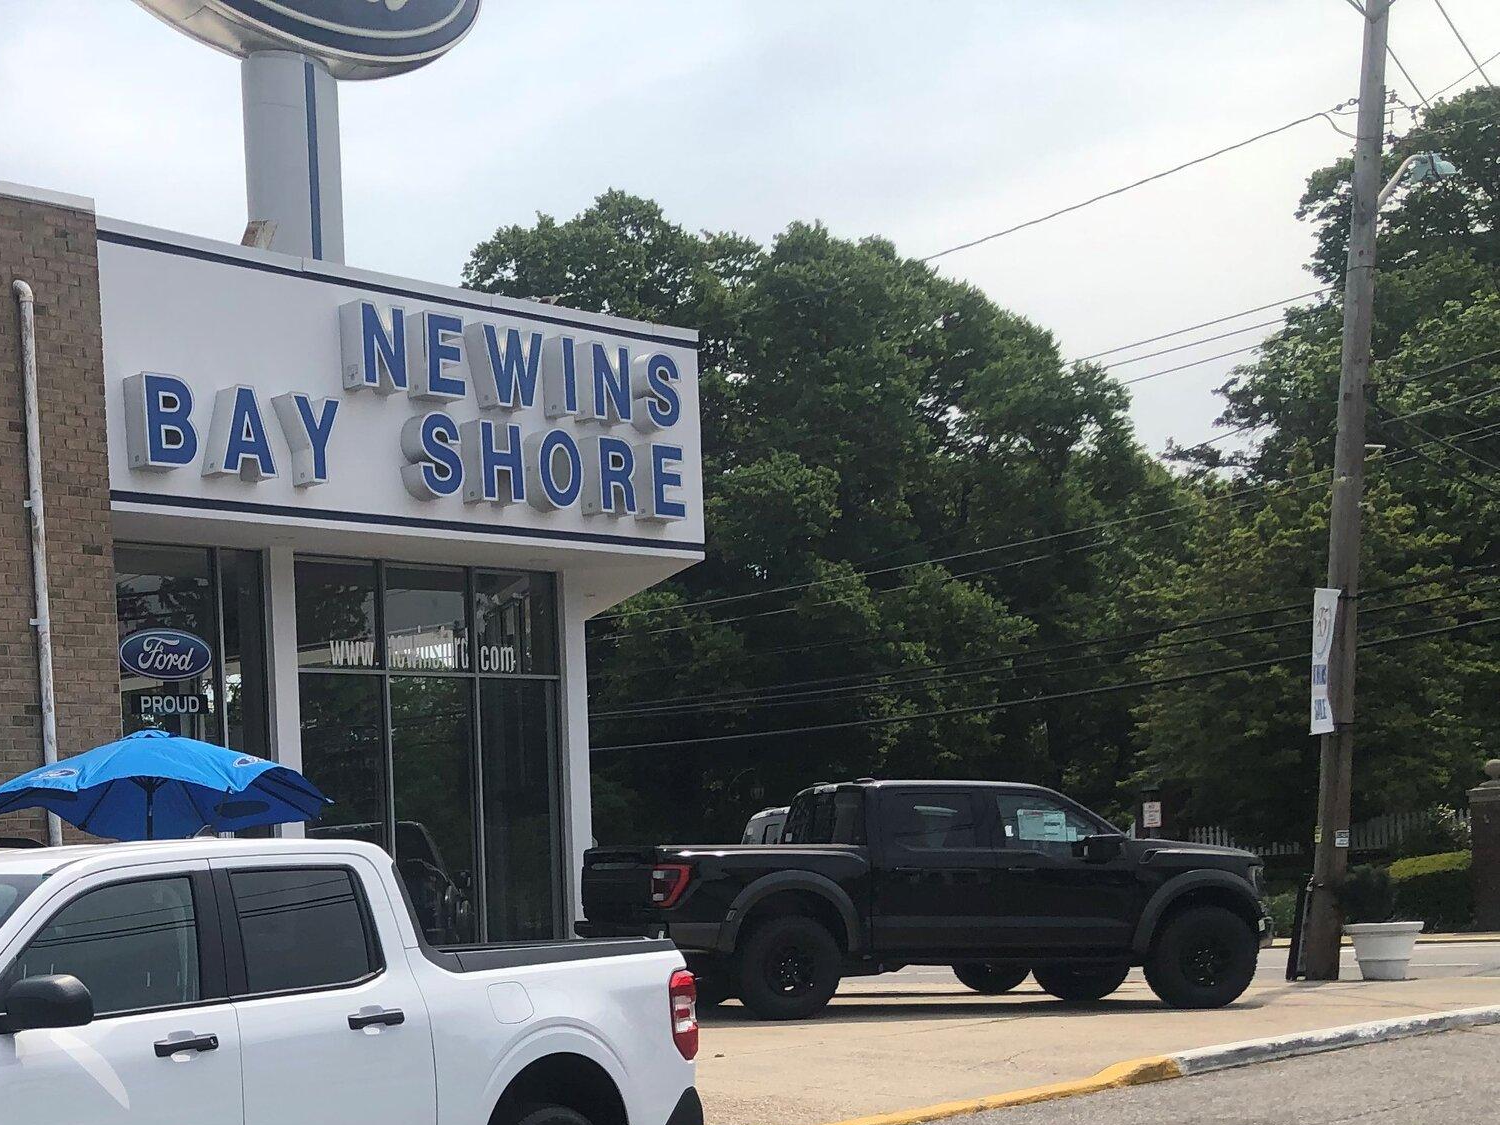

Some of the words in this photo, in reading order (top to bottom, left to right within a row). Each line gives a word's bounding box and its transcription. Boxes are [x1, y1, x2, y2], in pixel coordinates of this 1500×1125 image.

[358, 299, 682, 429] NEWINS
[142, 372, 341, 483] BAY
[420, 410, 688, 521] SHORE
[137, 636, 195, 671] Ford
[140, 695, 200, 713] PROUD
